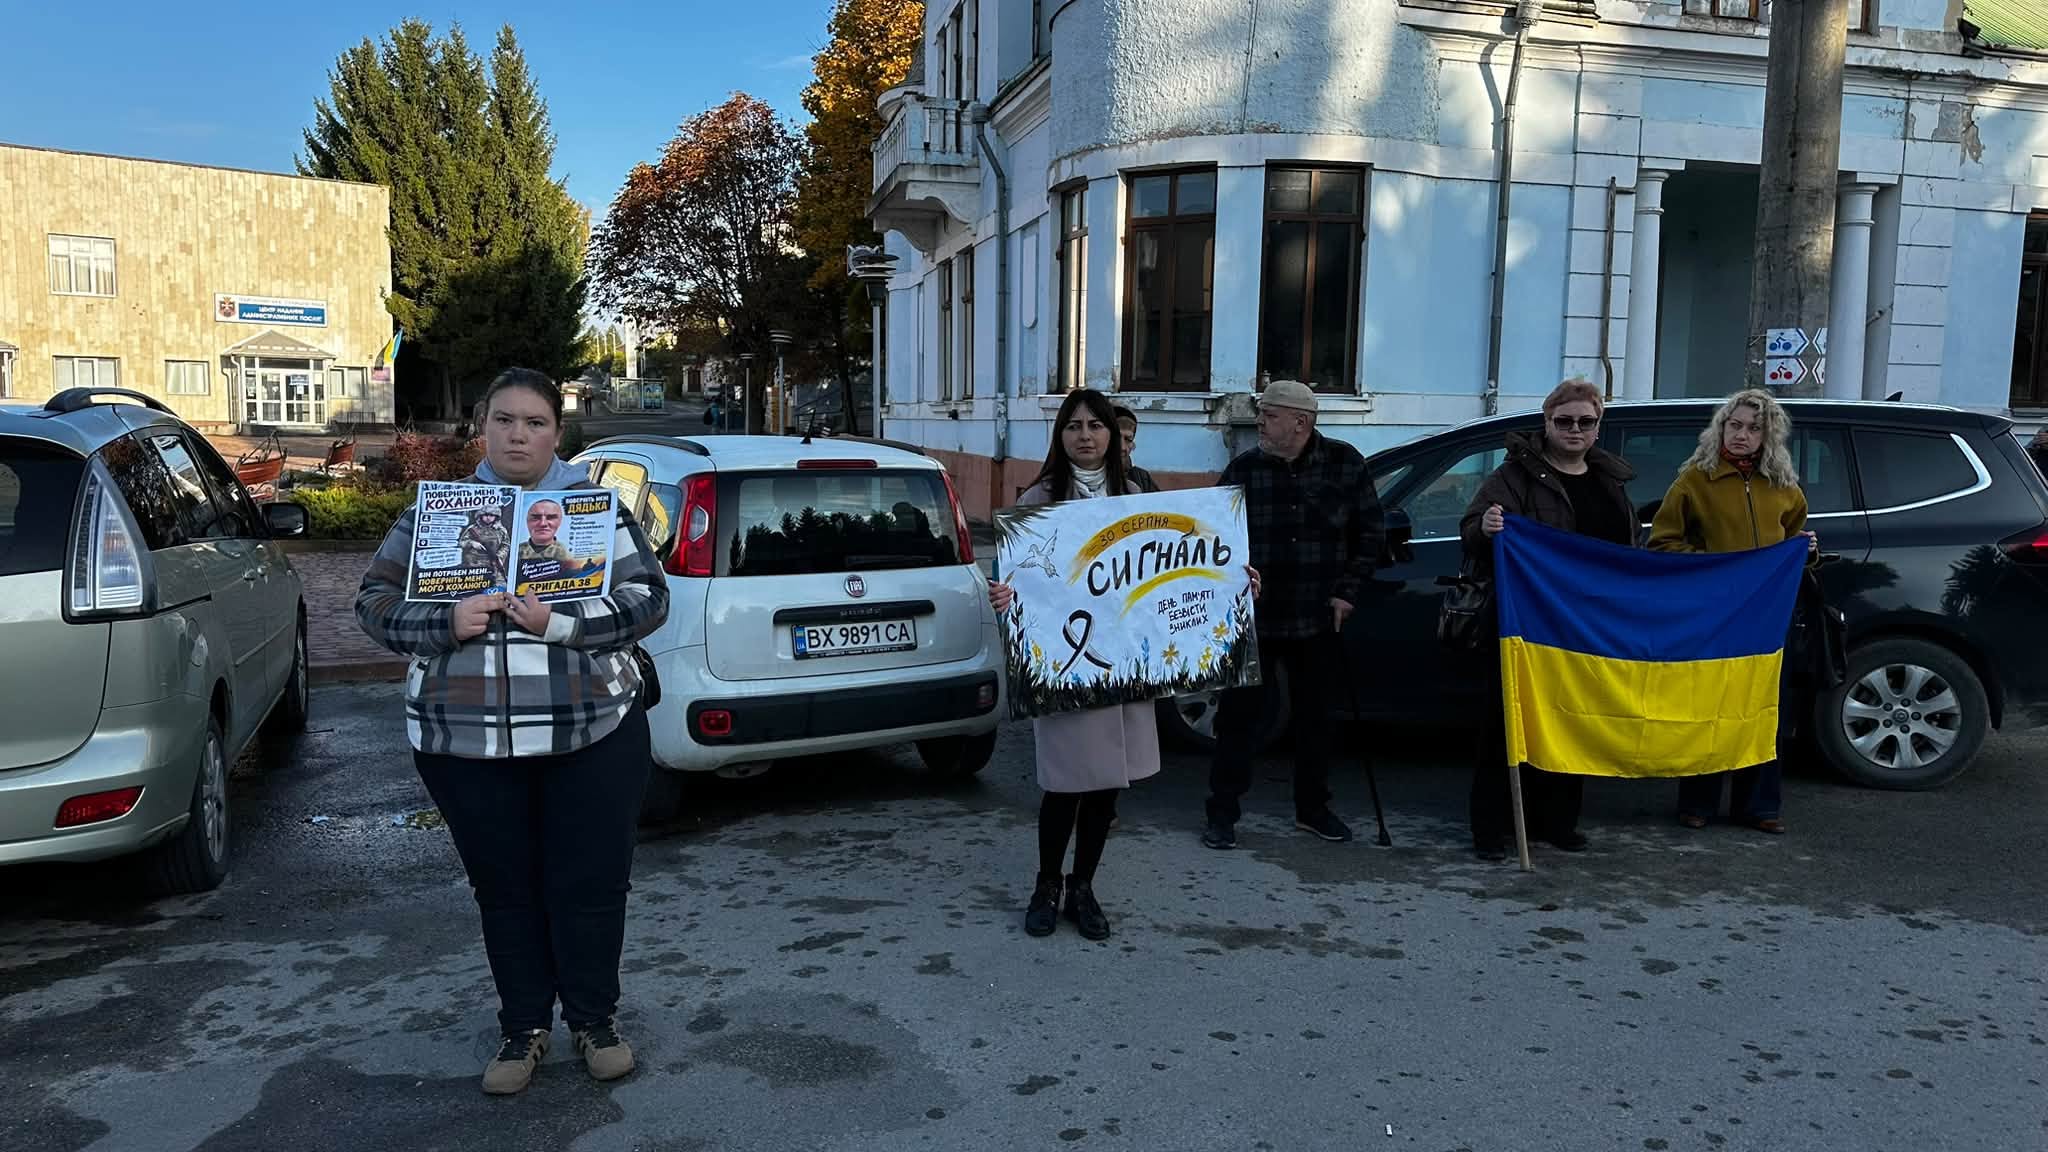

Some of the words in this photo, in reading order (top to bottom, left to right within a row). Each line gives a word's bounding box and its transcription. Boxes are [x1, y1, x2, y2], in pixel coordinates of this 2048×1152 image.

[425, 490, 472, 499] ПОВЕРНІТЬ
[425, 495, 500, 511] КОХАНОГО!
[567, 502, 608, 514] ДЯДЬКА
[1100, 530, 1115, 547] 30
[1121, 516, 1169, 533] СЕРПНЯ
[418, 571, 431, 579] ВІН
[432, 569, 467, 577] ПОТРІБЕН
[1087, 535, 1231, 597] СИГНАЛЬ
[418, 576, 463, 586] ПОВЕРНІТЬ
[418, 584, 445, 593] МОГО
[446, 580, 490, 592] КОХАНОГО!
[1158, 597, 1178, 615] ДЕНЬ
[1168, 603, 1207, 621] БЕЗВІСТИ
[1169, 614, 1209, 635] ЗНИКЛИХ
[807, 627, 835, 649] BX
[839, 624, 881, 647] 9891
[885, 622, 911, 642] CA
[796, 642, 806, 650] UA
